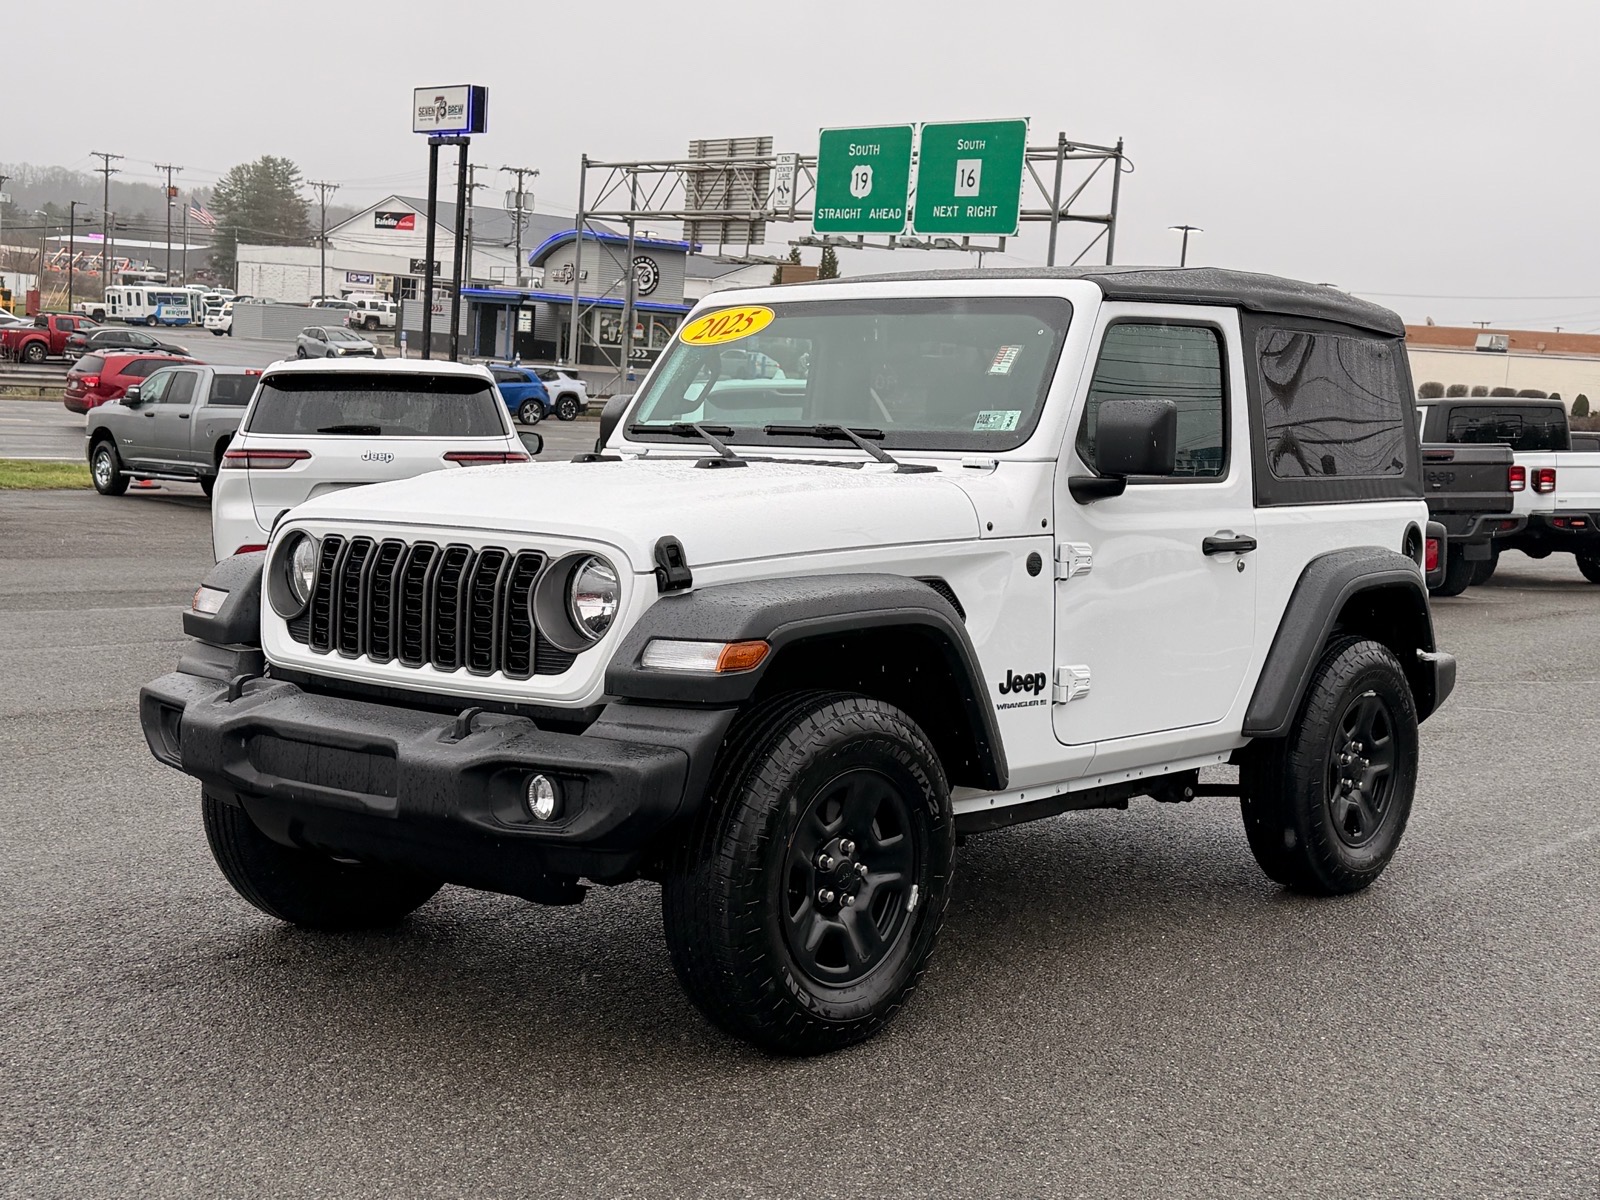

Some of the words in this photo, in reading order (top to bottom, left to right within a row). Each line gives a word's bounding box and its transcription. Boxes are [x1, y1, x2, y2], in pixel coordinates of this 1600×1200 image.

[418, 106, 435, 117] SEVEN
[448, 104, 464, 115] BREW
[854, 172, 869, 191] 19
[960, 168, 976, 188] 16
[818, 208, 862, 220] STRAIGHT
[869, 208, 902, 220] AHEAD
[933, 206, 959, 217] NEXT
[966, 206, 998, 217] RIGHT
[691, 309, 762, 341] 2025
[361, 450, 394, 463] Jeep
[999, 669, 1046, 696] Jeep
[997, 700, 1039, 710] WRANGLER
